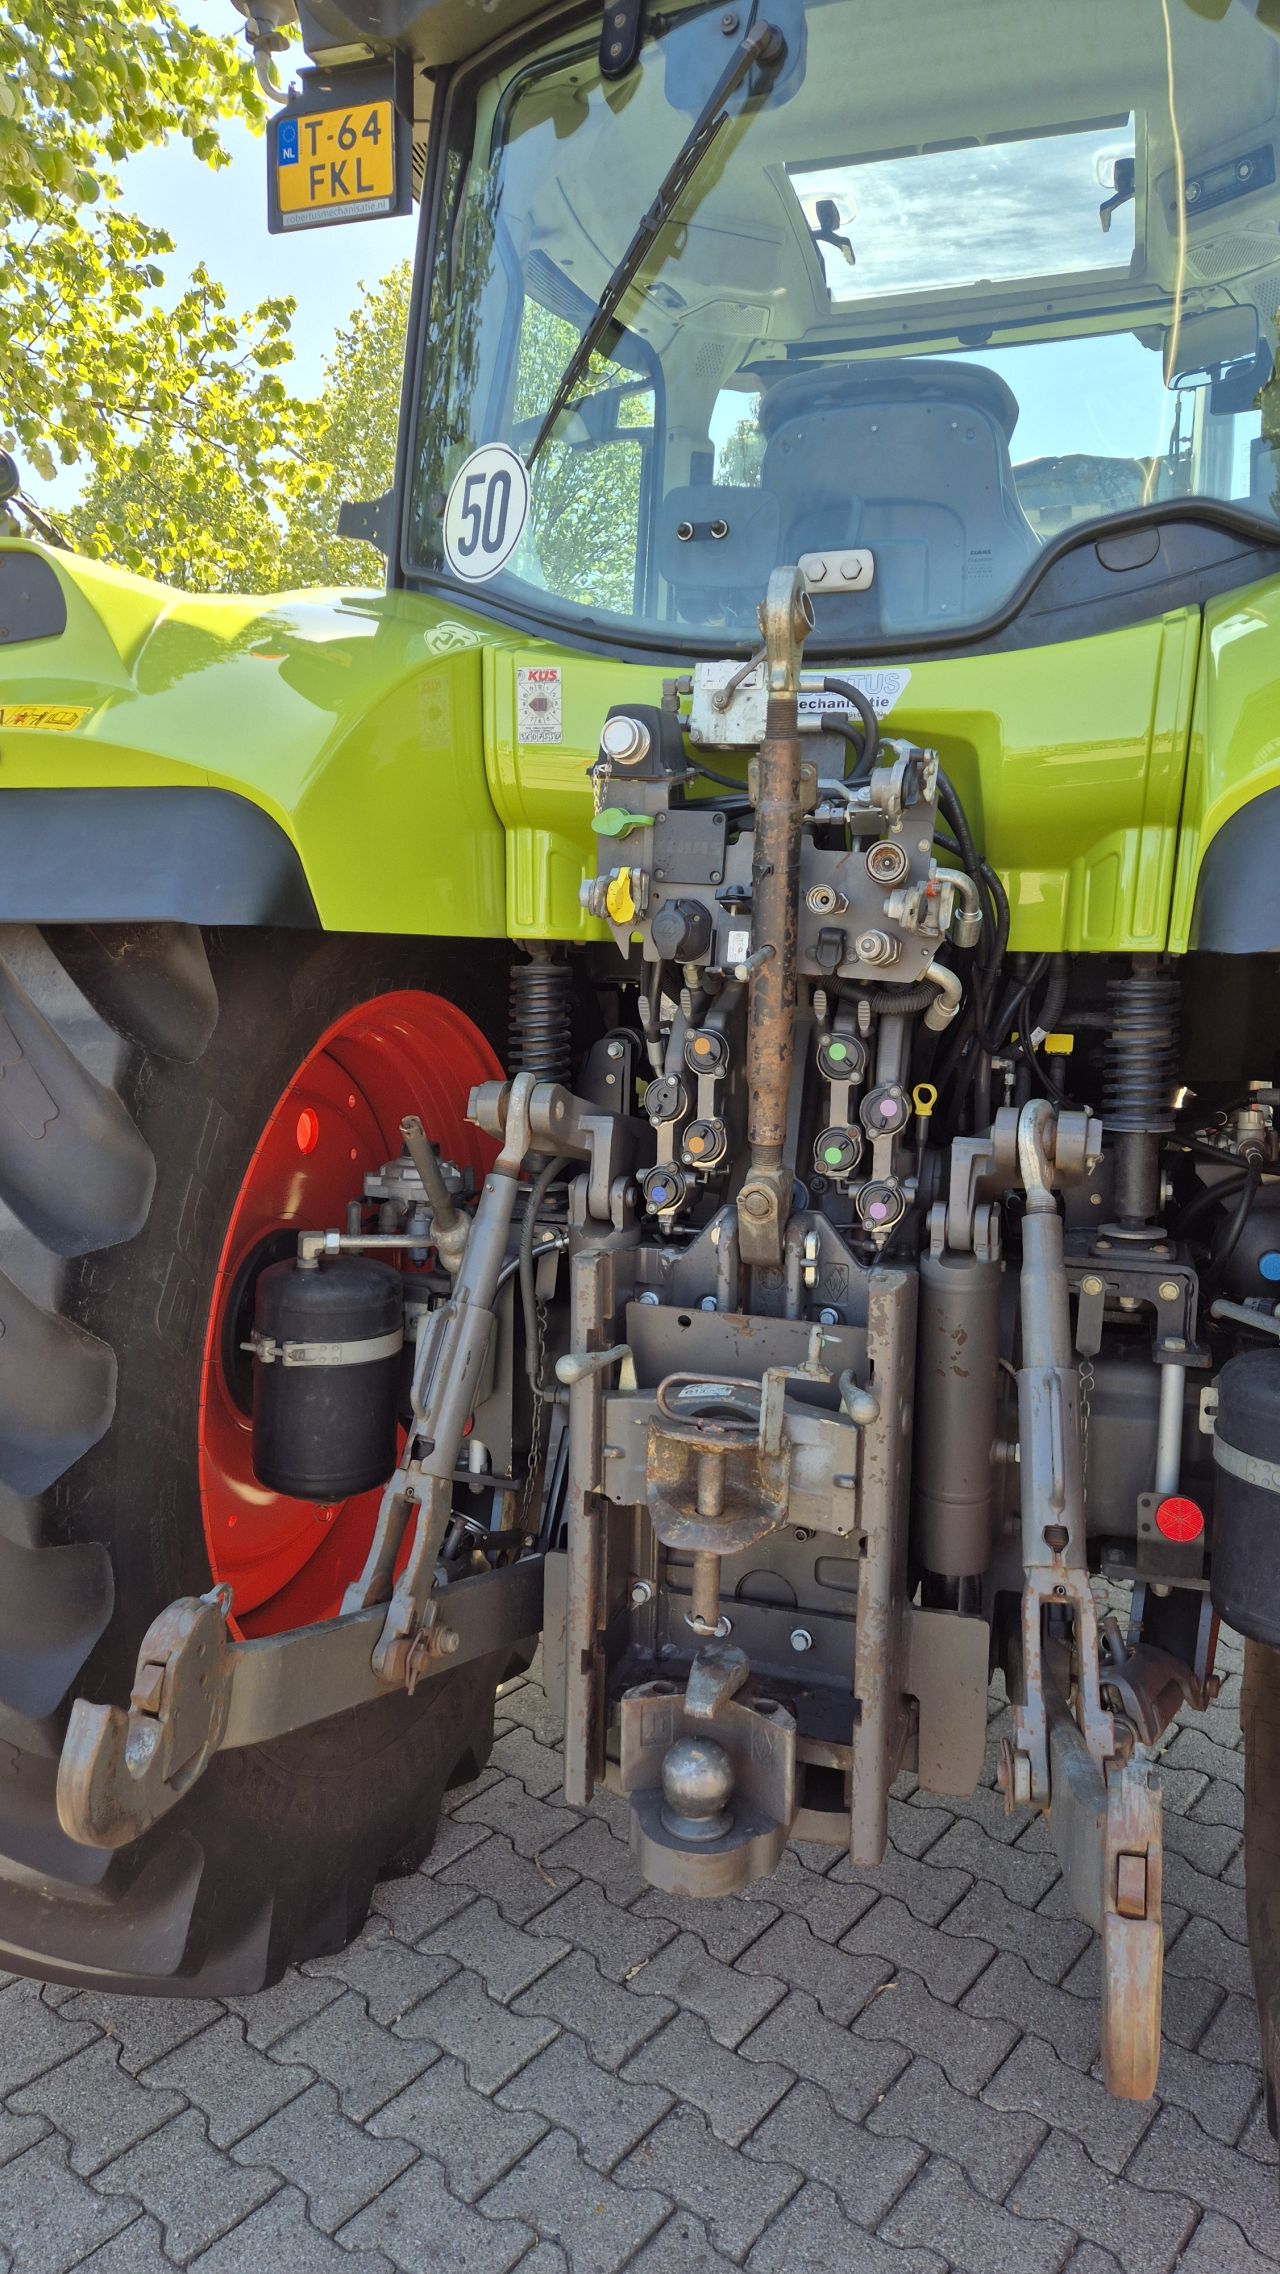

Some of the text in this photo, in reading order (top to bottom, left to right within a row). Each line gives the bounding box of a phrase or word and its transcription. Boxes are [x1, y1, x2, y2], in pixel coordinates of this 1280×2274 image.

[283, 148, 295, 159] NL
[305, 110, 381, 156] T-64
[310, 157, 374, 201] FKL
[286, 201, 386, 222] robertusmechanisatie.nl
[457, 469, 512, 557] 50
